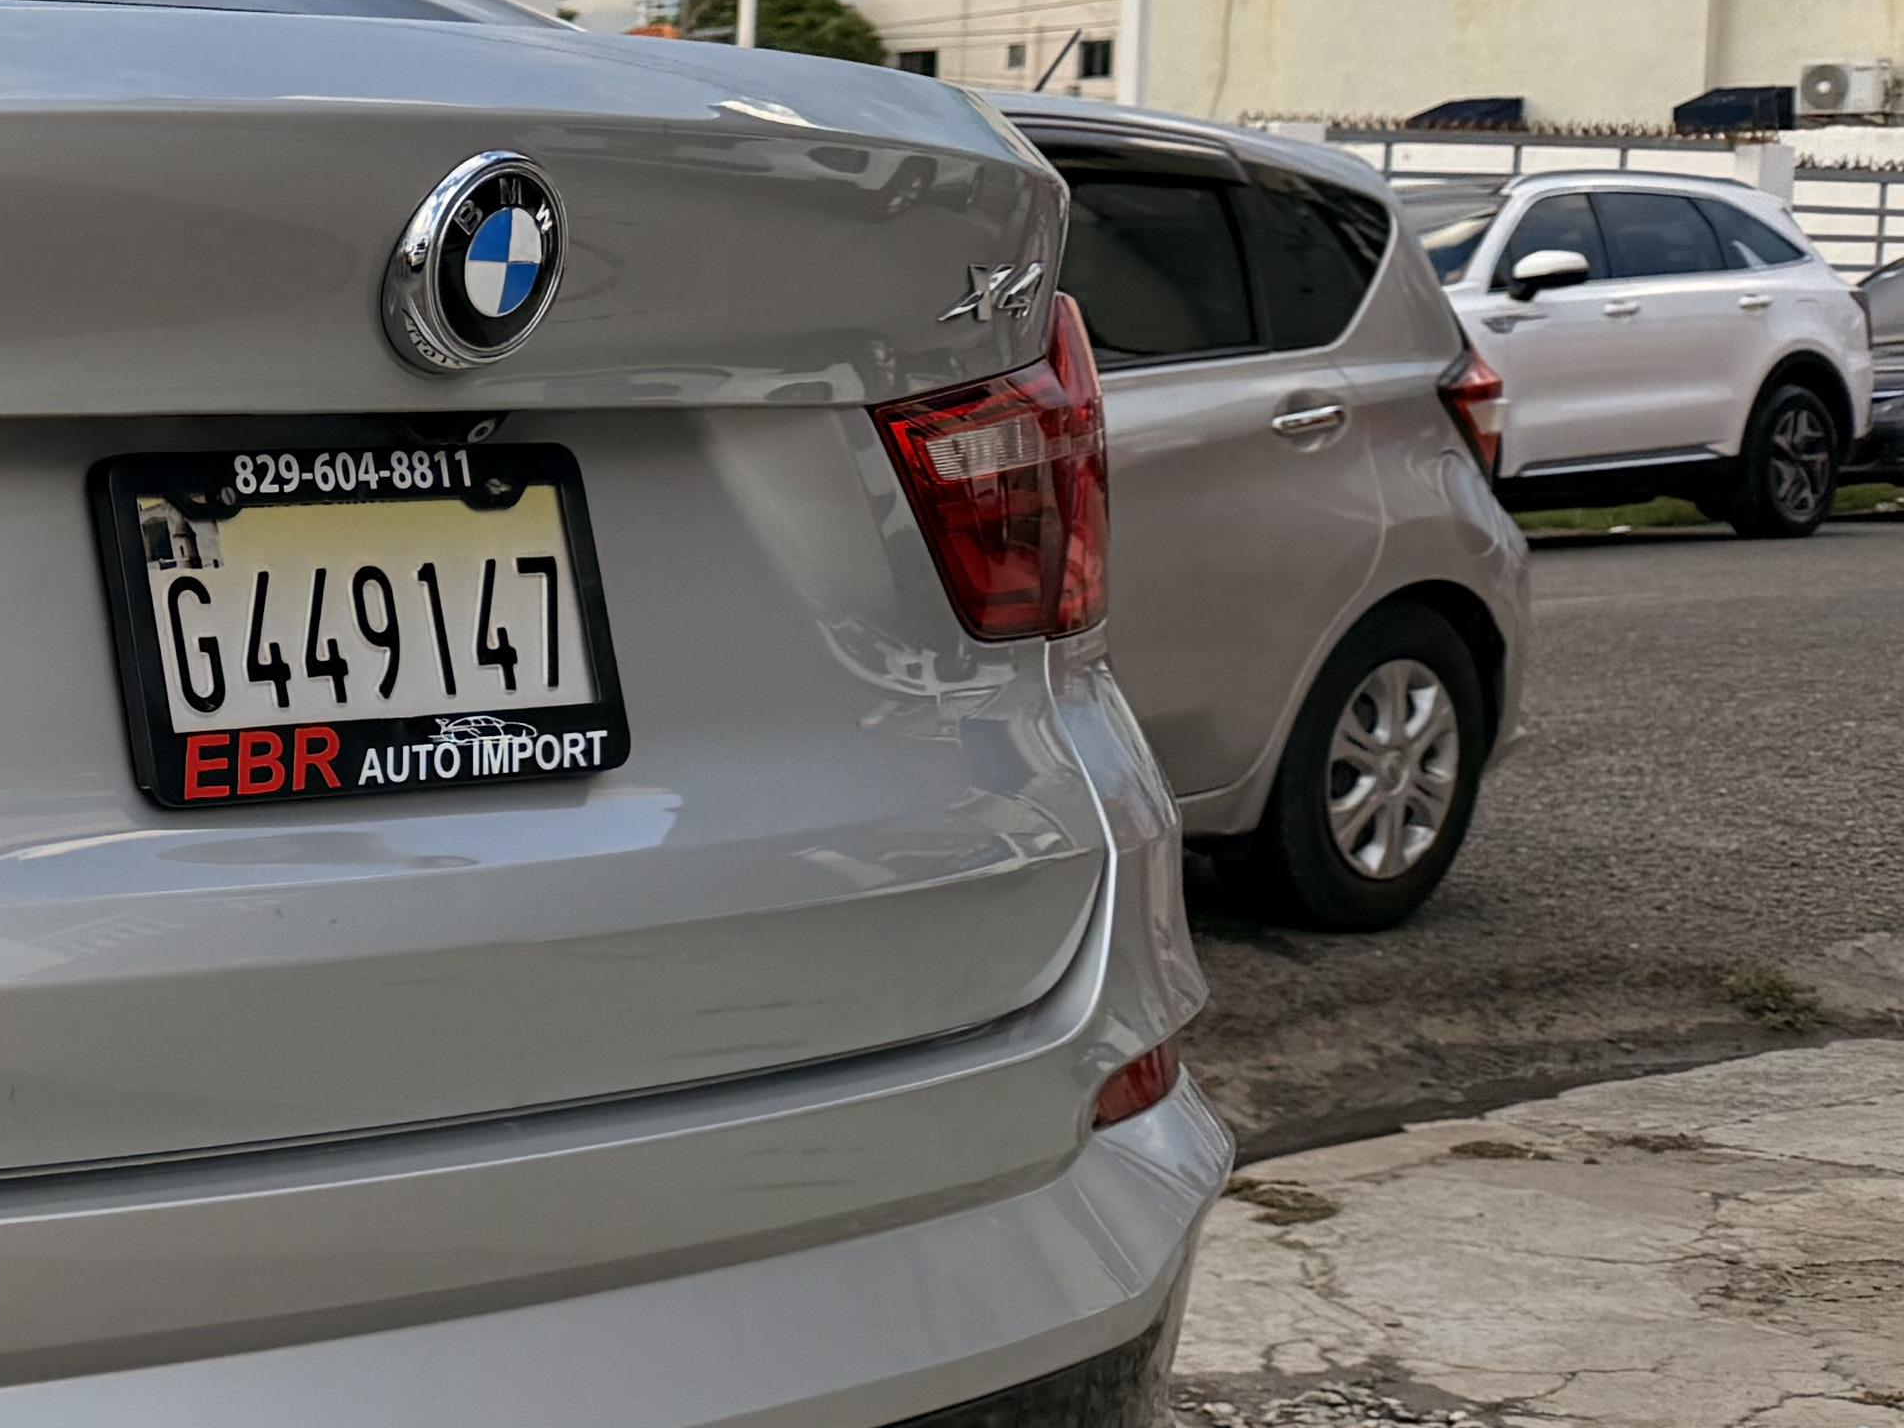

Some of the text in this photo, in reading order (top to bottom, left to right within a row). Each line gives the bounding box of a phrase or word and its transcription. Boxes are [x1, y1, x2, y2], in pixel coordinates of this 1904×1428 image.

[453, 177, 553, 236] BMW
[936, 262, 1043, 322] X4
[233, 449, 472, 495] 829-604-8811
[167, 555, 560, 714] G449147
[184, 726, 608, 801] EBR AUTO IMPORT
